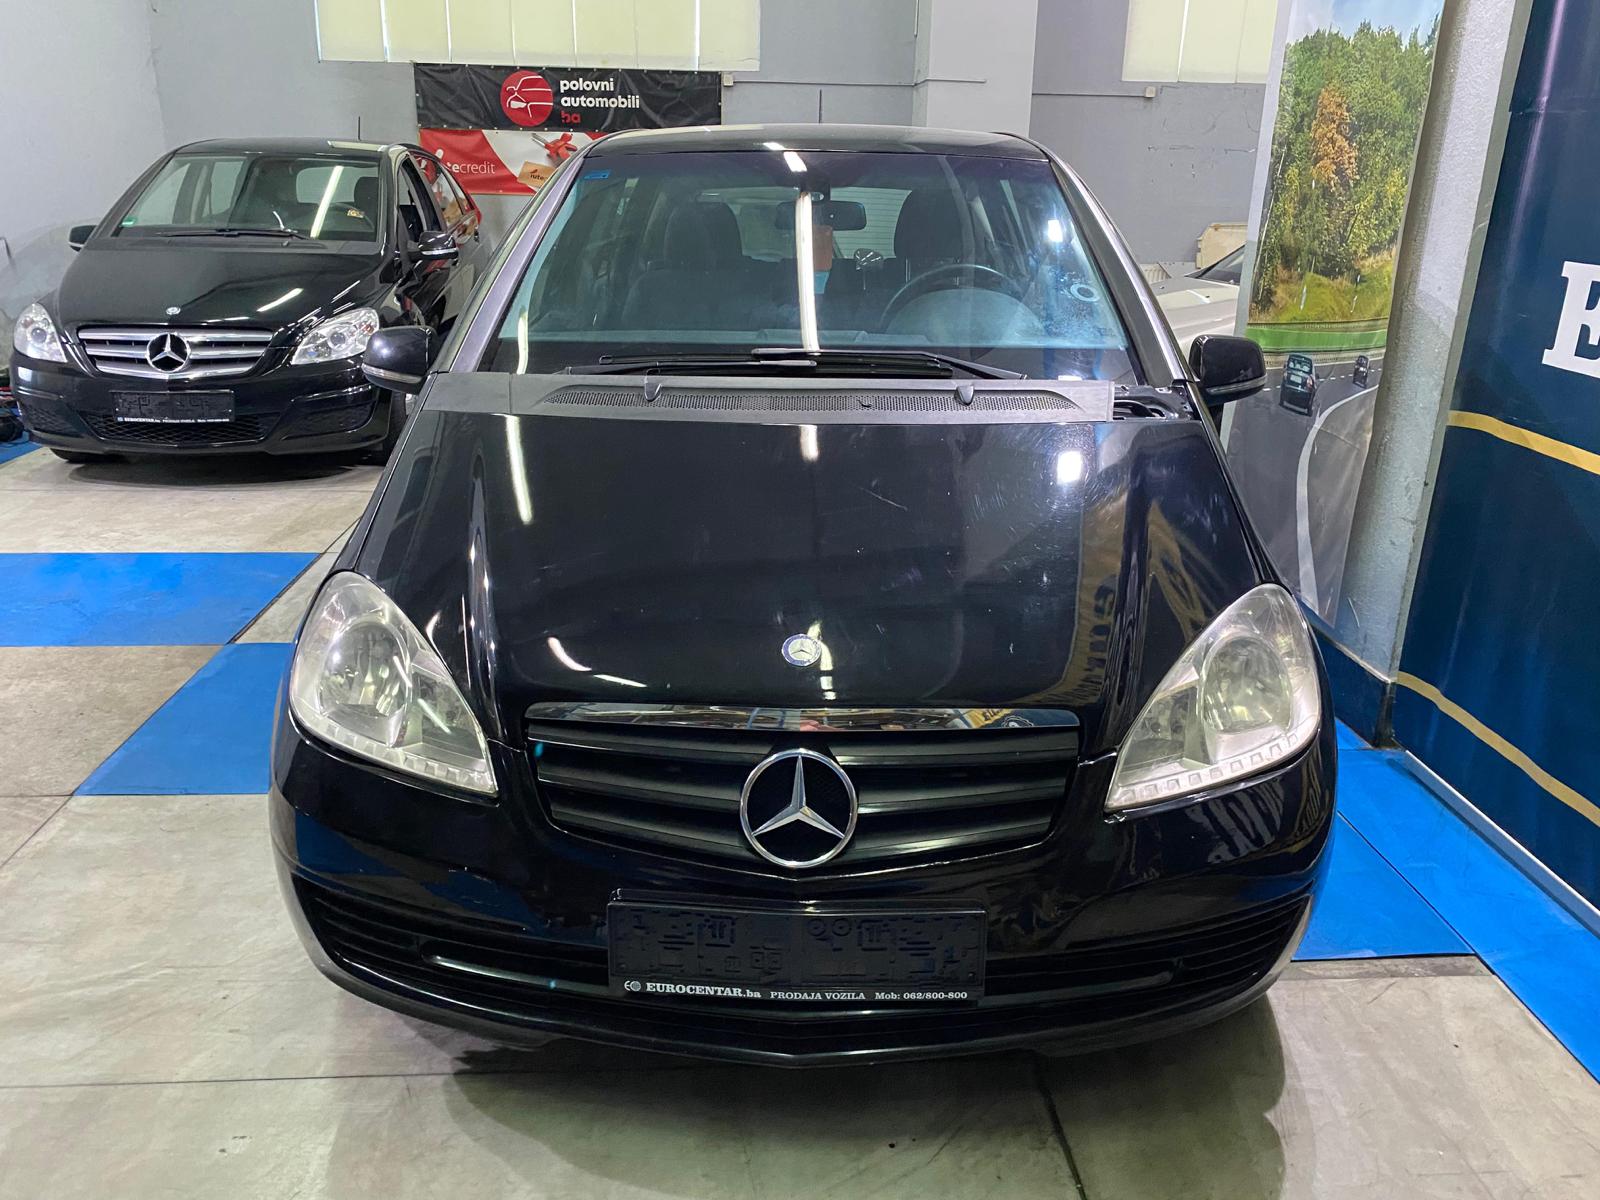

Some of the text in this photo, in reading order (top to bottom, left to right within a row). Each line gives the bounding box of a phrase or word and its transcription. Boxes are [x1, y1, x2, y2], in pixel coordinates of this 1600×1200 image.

[560, 77, 614, 93] polovni
[560, 94, 640, 109] automobili
[646, 982, 968, 1000] EUROCENTAR.ba PRODAJA VOZILA Mob: 062/800-800
